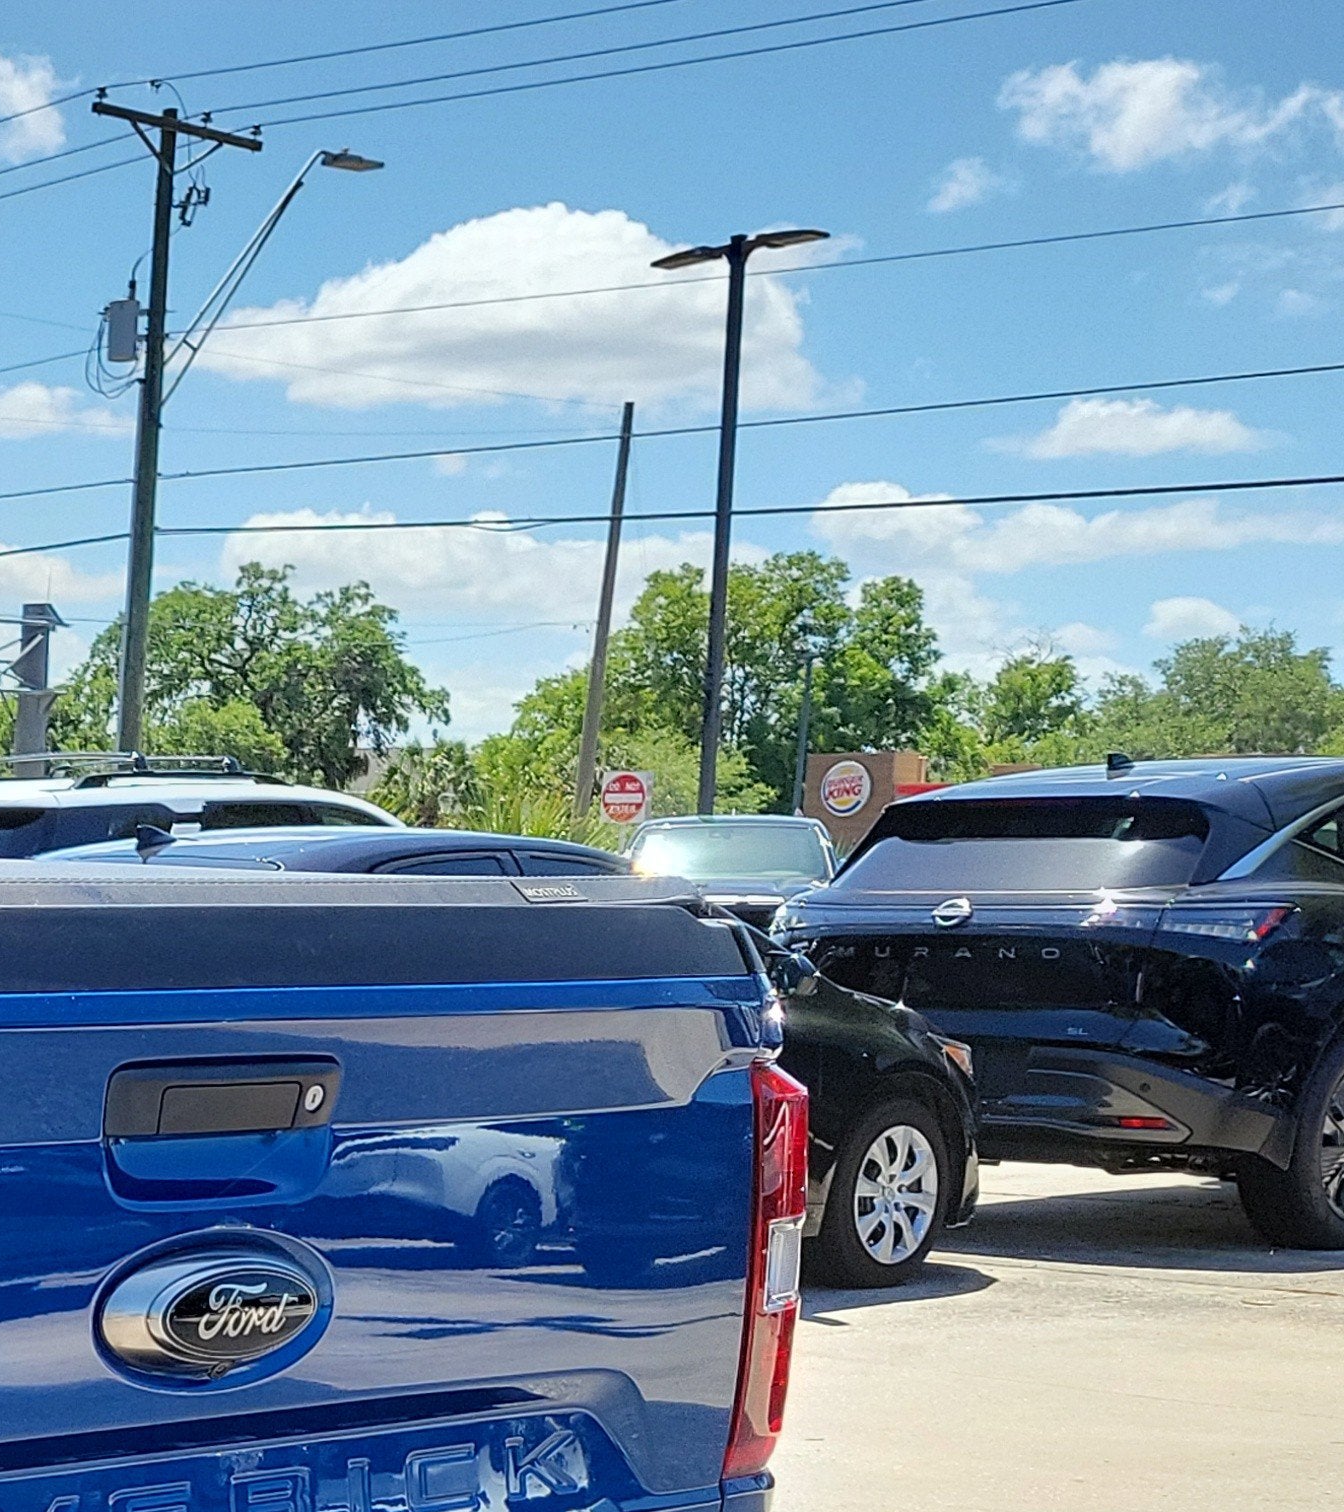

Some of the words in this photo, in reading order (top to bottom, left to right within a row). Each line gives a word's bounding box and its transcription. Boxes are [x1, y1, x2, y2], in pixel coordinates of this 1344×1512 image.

[607, 781, 621, 792] DO
[625, 781, 641, 791] NOT
[826, 784, 864, 800] KING
[837, 945, 1061, 960] MURANO
[197, 1281, 300, 1341] Ford
